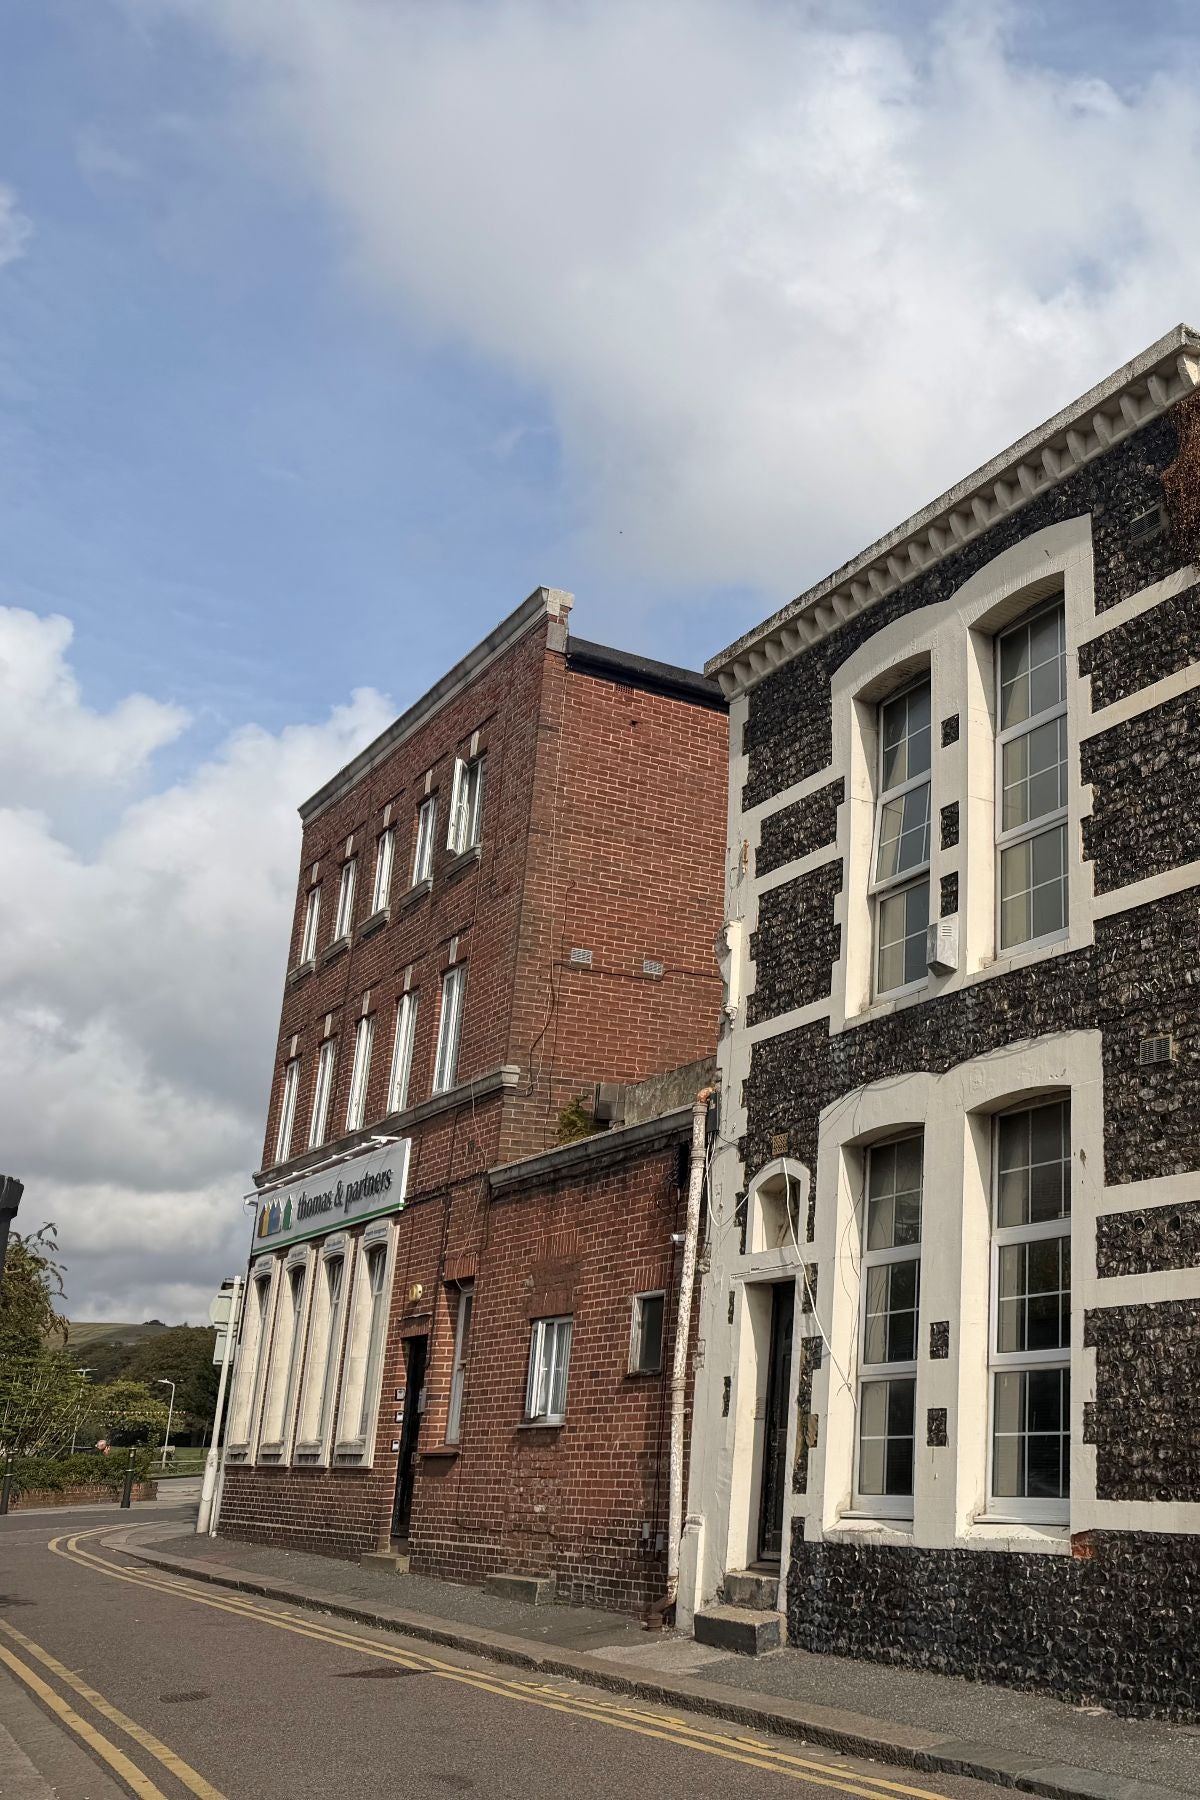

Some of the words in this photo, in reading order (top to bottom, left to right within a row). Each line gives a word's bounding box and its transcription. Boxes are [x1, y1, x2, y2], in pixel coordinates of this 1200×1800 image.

[297, 1191, 332, 1221] thomas
[334, 1180, 344, 1208] &
[344, 1168, 392, 1214] partners
